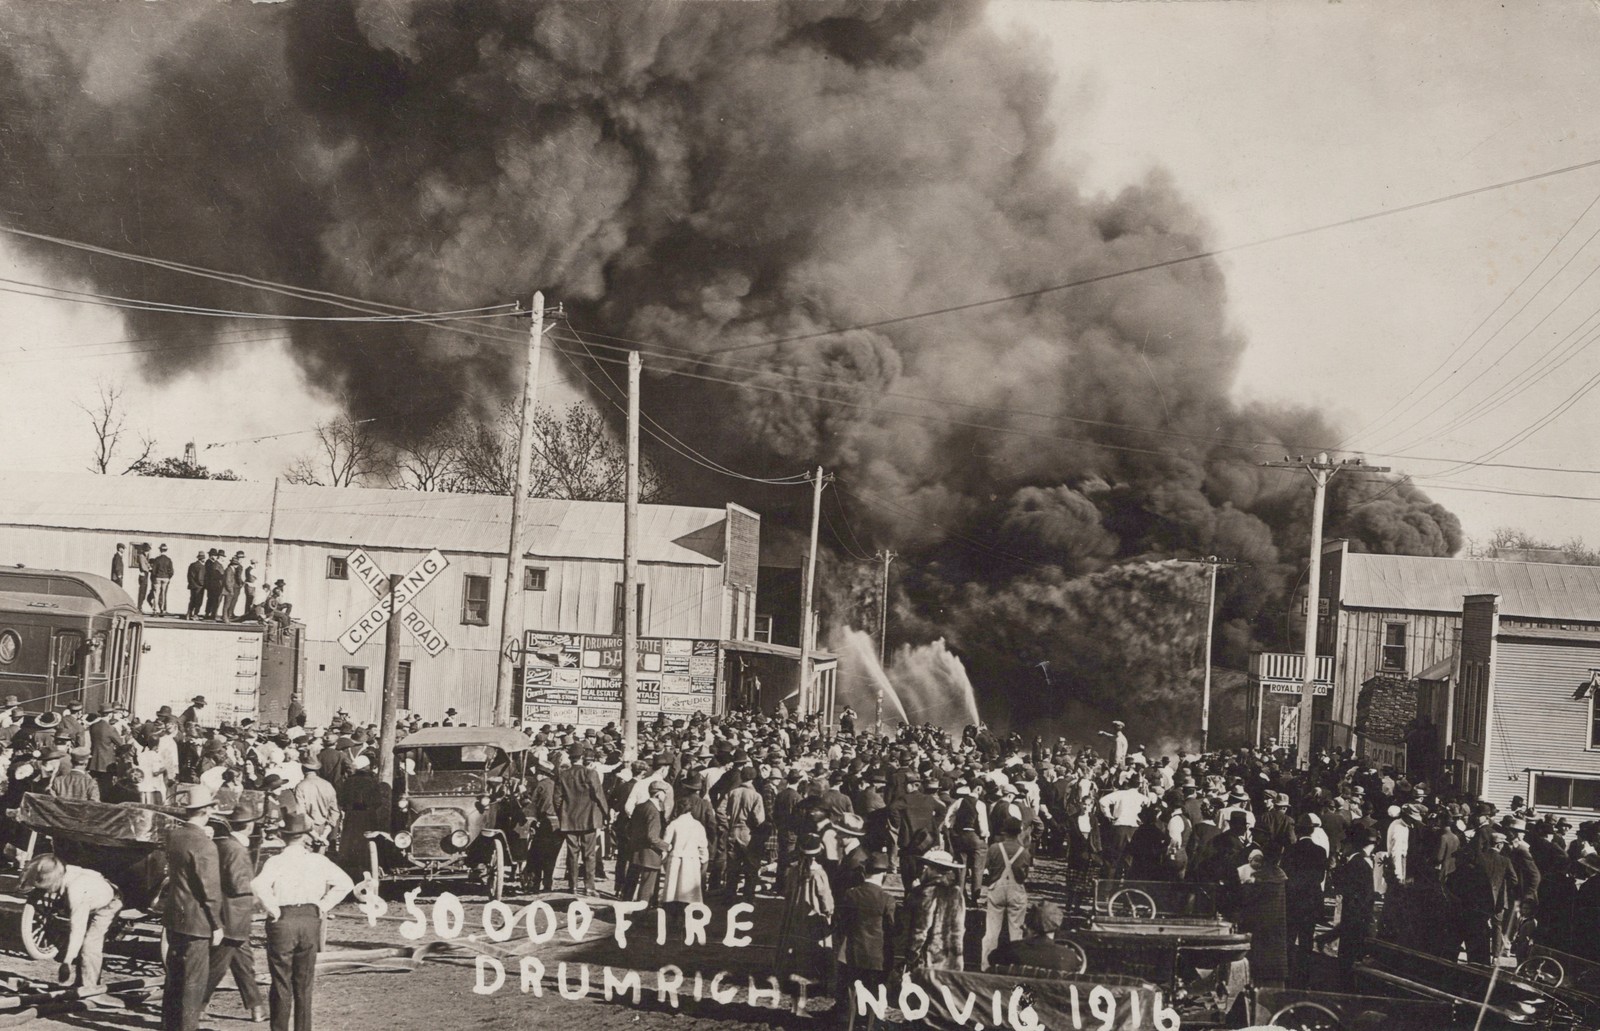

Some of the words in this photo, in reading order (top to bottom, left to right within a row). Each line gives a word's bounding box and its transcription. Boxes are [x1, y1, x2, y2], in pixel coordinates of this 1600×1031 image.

[348, 558, 438, 644] CROSSING
[352, 554, 386, 596] RAIL
[403, 611, 441, 651] ROAD
[585, 637, 622, 650] DRUMRIG
[601, 650, 645, 669] BAK
[1271, 684, 1295, 693] ROYAL
[672, 697, 711, 707] STUDIO
